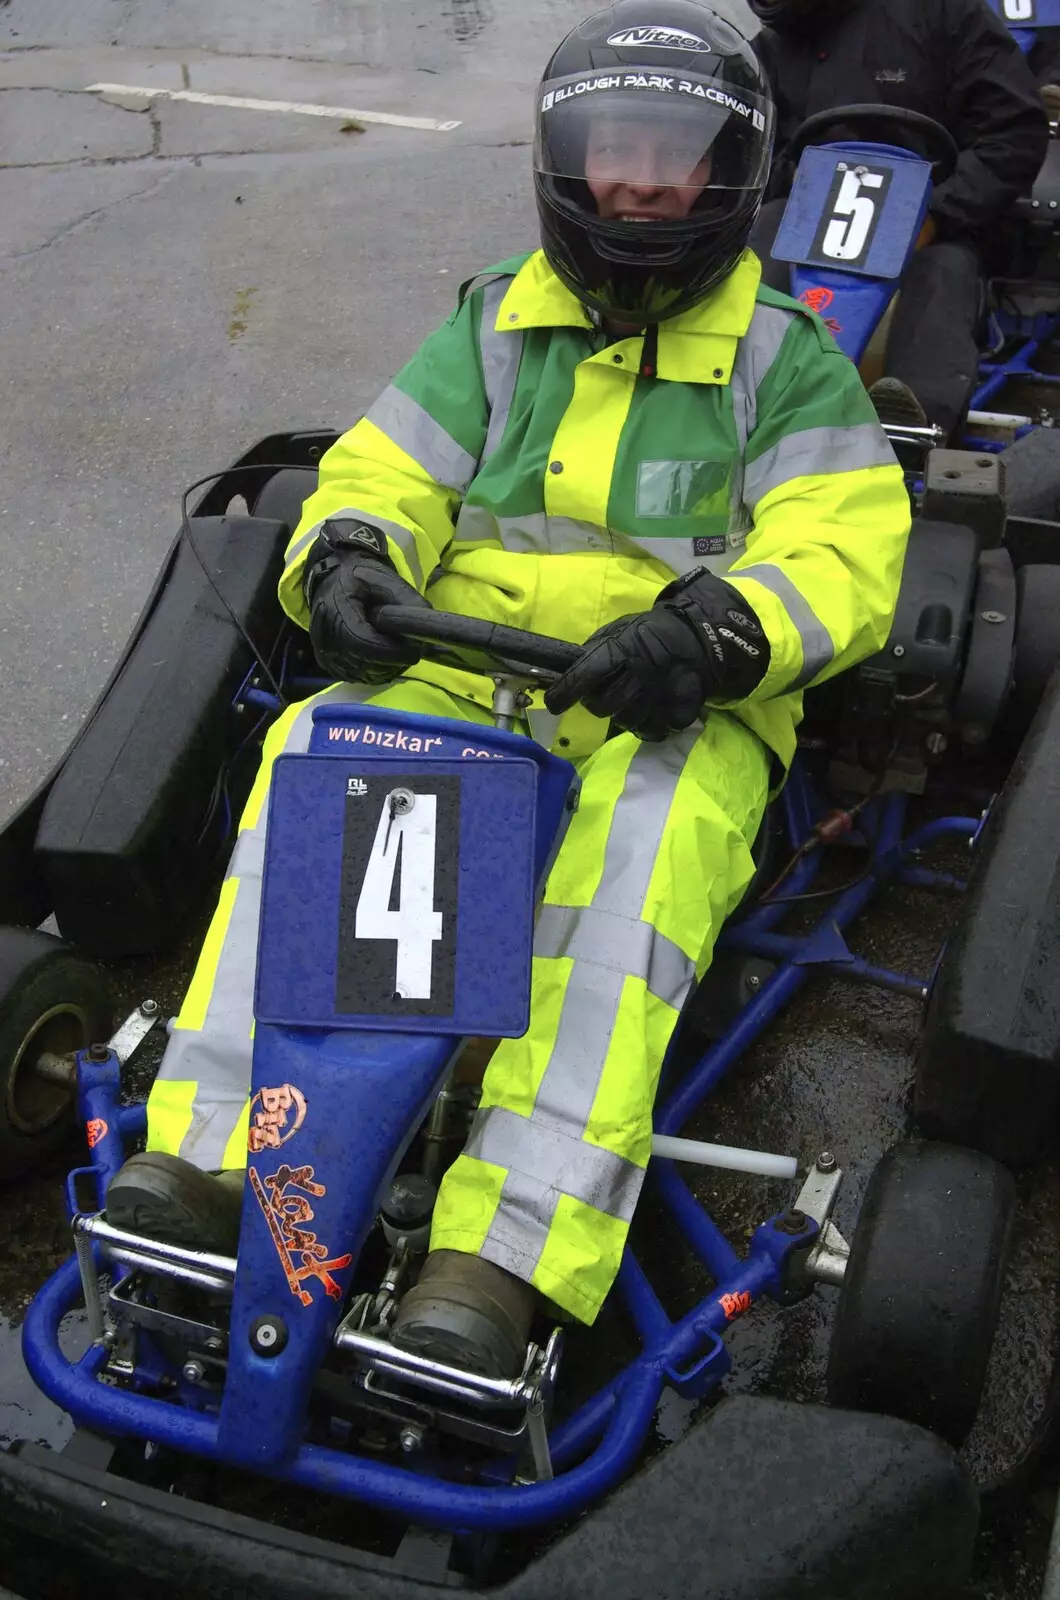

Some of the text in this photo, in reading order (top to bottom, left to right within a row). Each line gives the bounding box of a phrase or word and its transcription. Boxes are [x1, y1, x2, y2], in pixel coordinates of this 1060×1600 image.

[620, 27, 700, 48] Nitro
[555, 76, 621, 103] ELLOUGH
[624, 74, 675, 90] PARK
[678, 80, 752, 118] RACEWAY
[822, 170, 884, 260] 5
[354, 793, 443, 1000] 4
